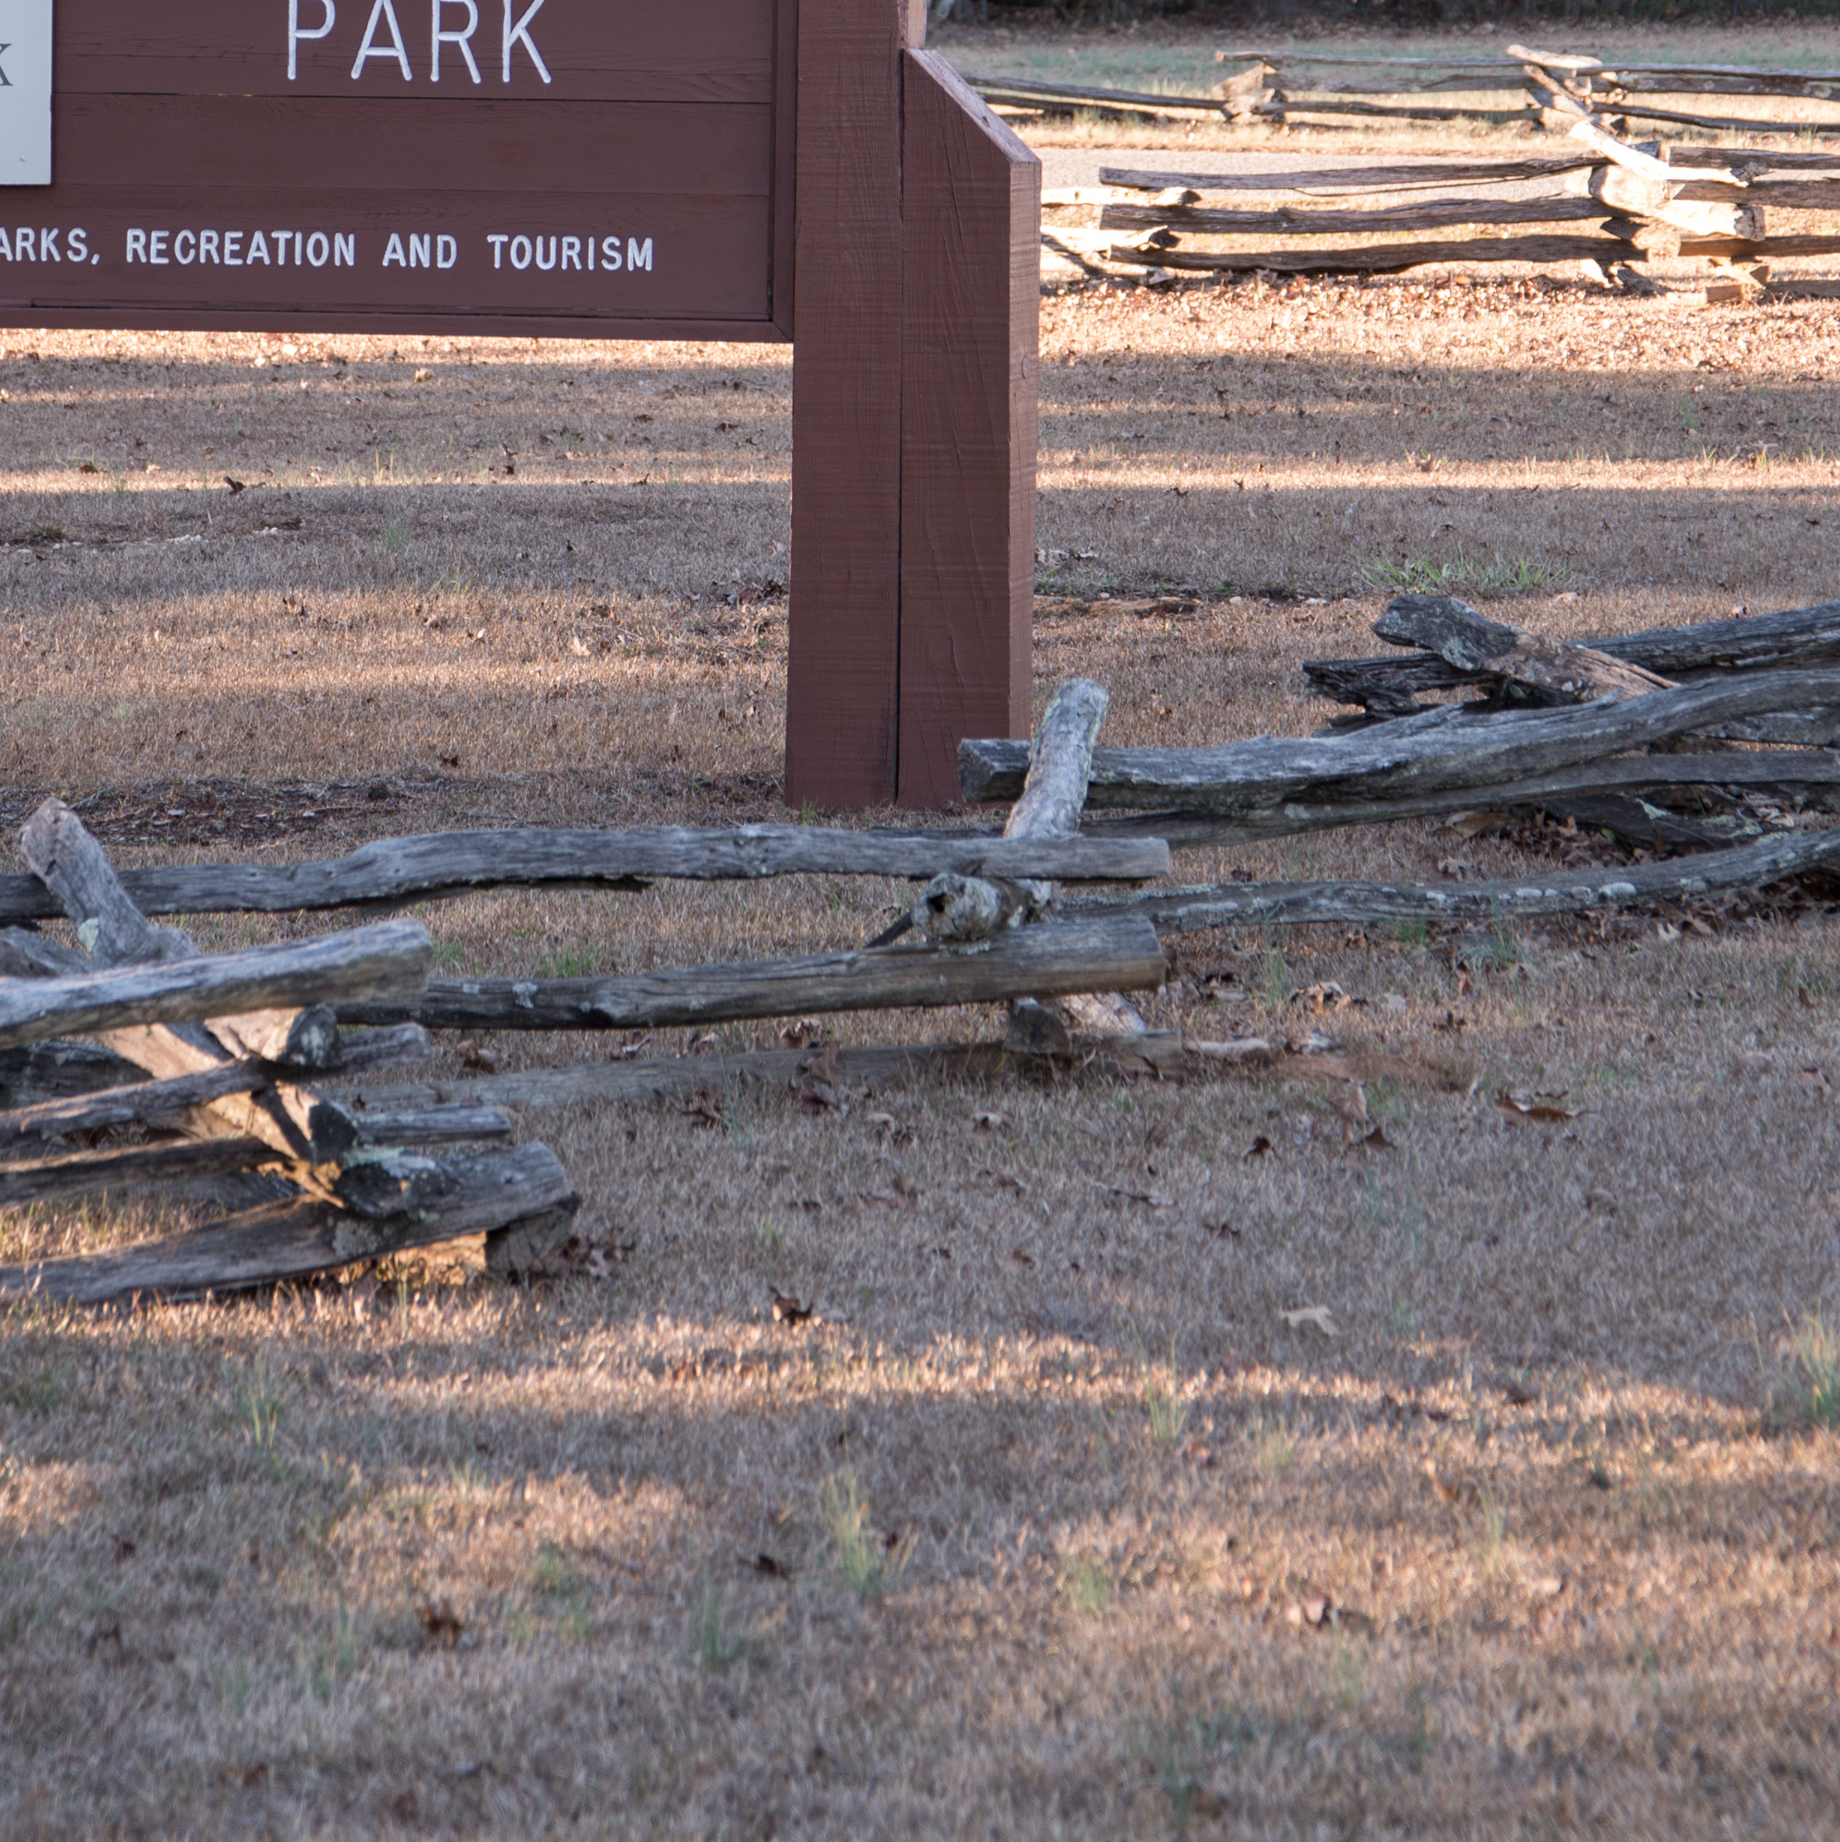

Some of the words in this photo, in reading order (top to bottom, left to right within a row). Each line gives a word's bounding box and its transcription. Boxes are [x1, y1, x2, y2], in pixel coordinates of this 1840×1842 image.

[126, 228, 355, 267] RECREATION
[382, 232, 457, 269] AND
[486, 234, 653, 272] TOURISM
